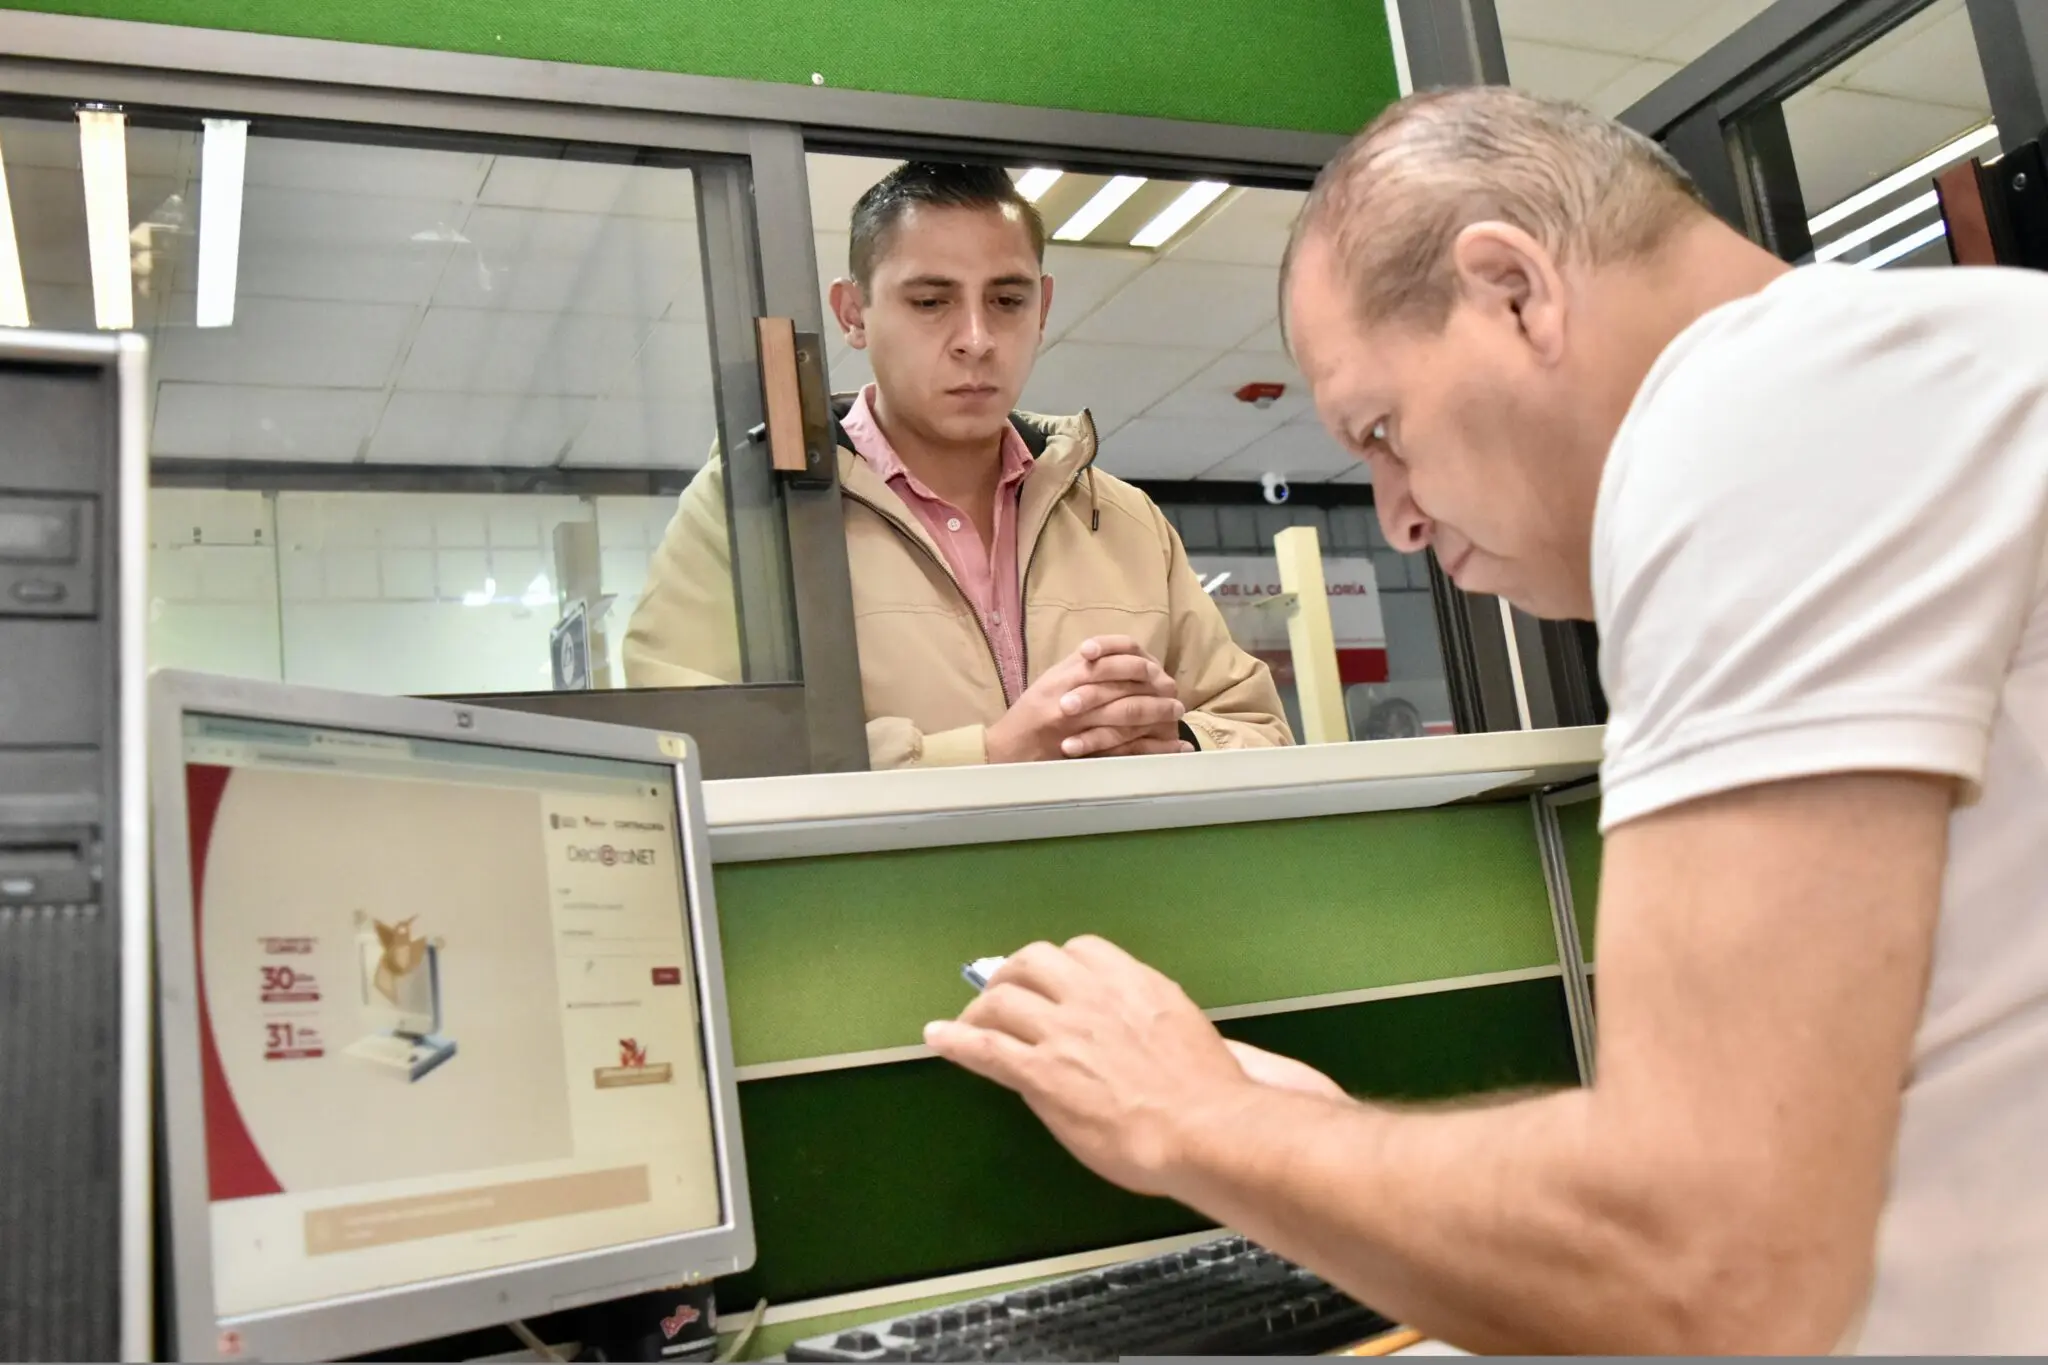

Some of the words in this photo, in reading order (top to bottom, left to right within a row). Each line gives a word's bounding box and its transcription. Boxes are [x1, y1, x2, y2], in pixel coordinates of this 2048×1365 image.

[1219, 583, 1241, 596] DE
[1243, 583, 1263, 596] LA
[1266, 580, 1368, 596] COLORÍA
[260, 966, 296, 990] 30
[265, 1022, 294, 1048] 31
